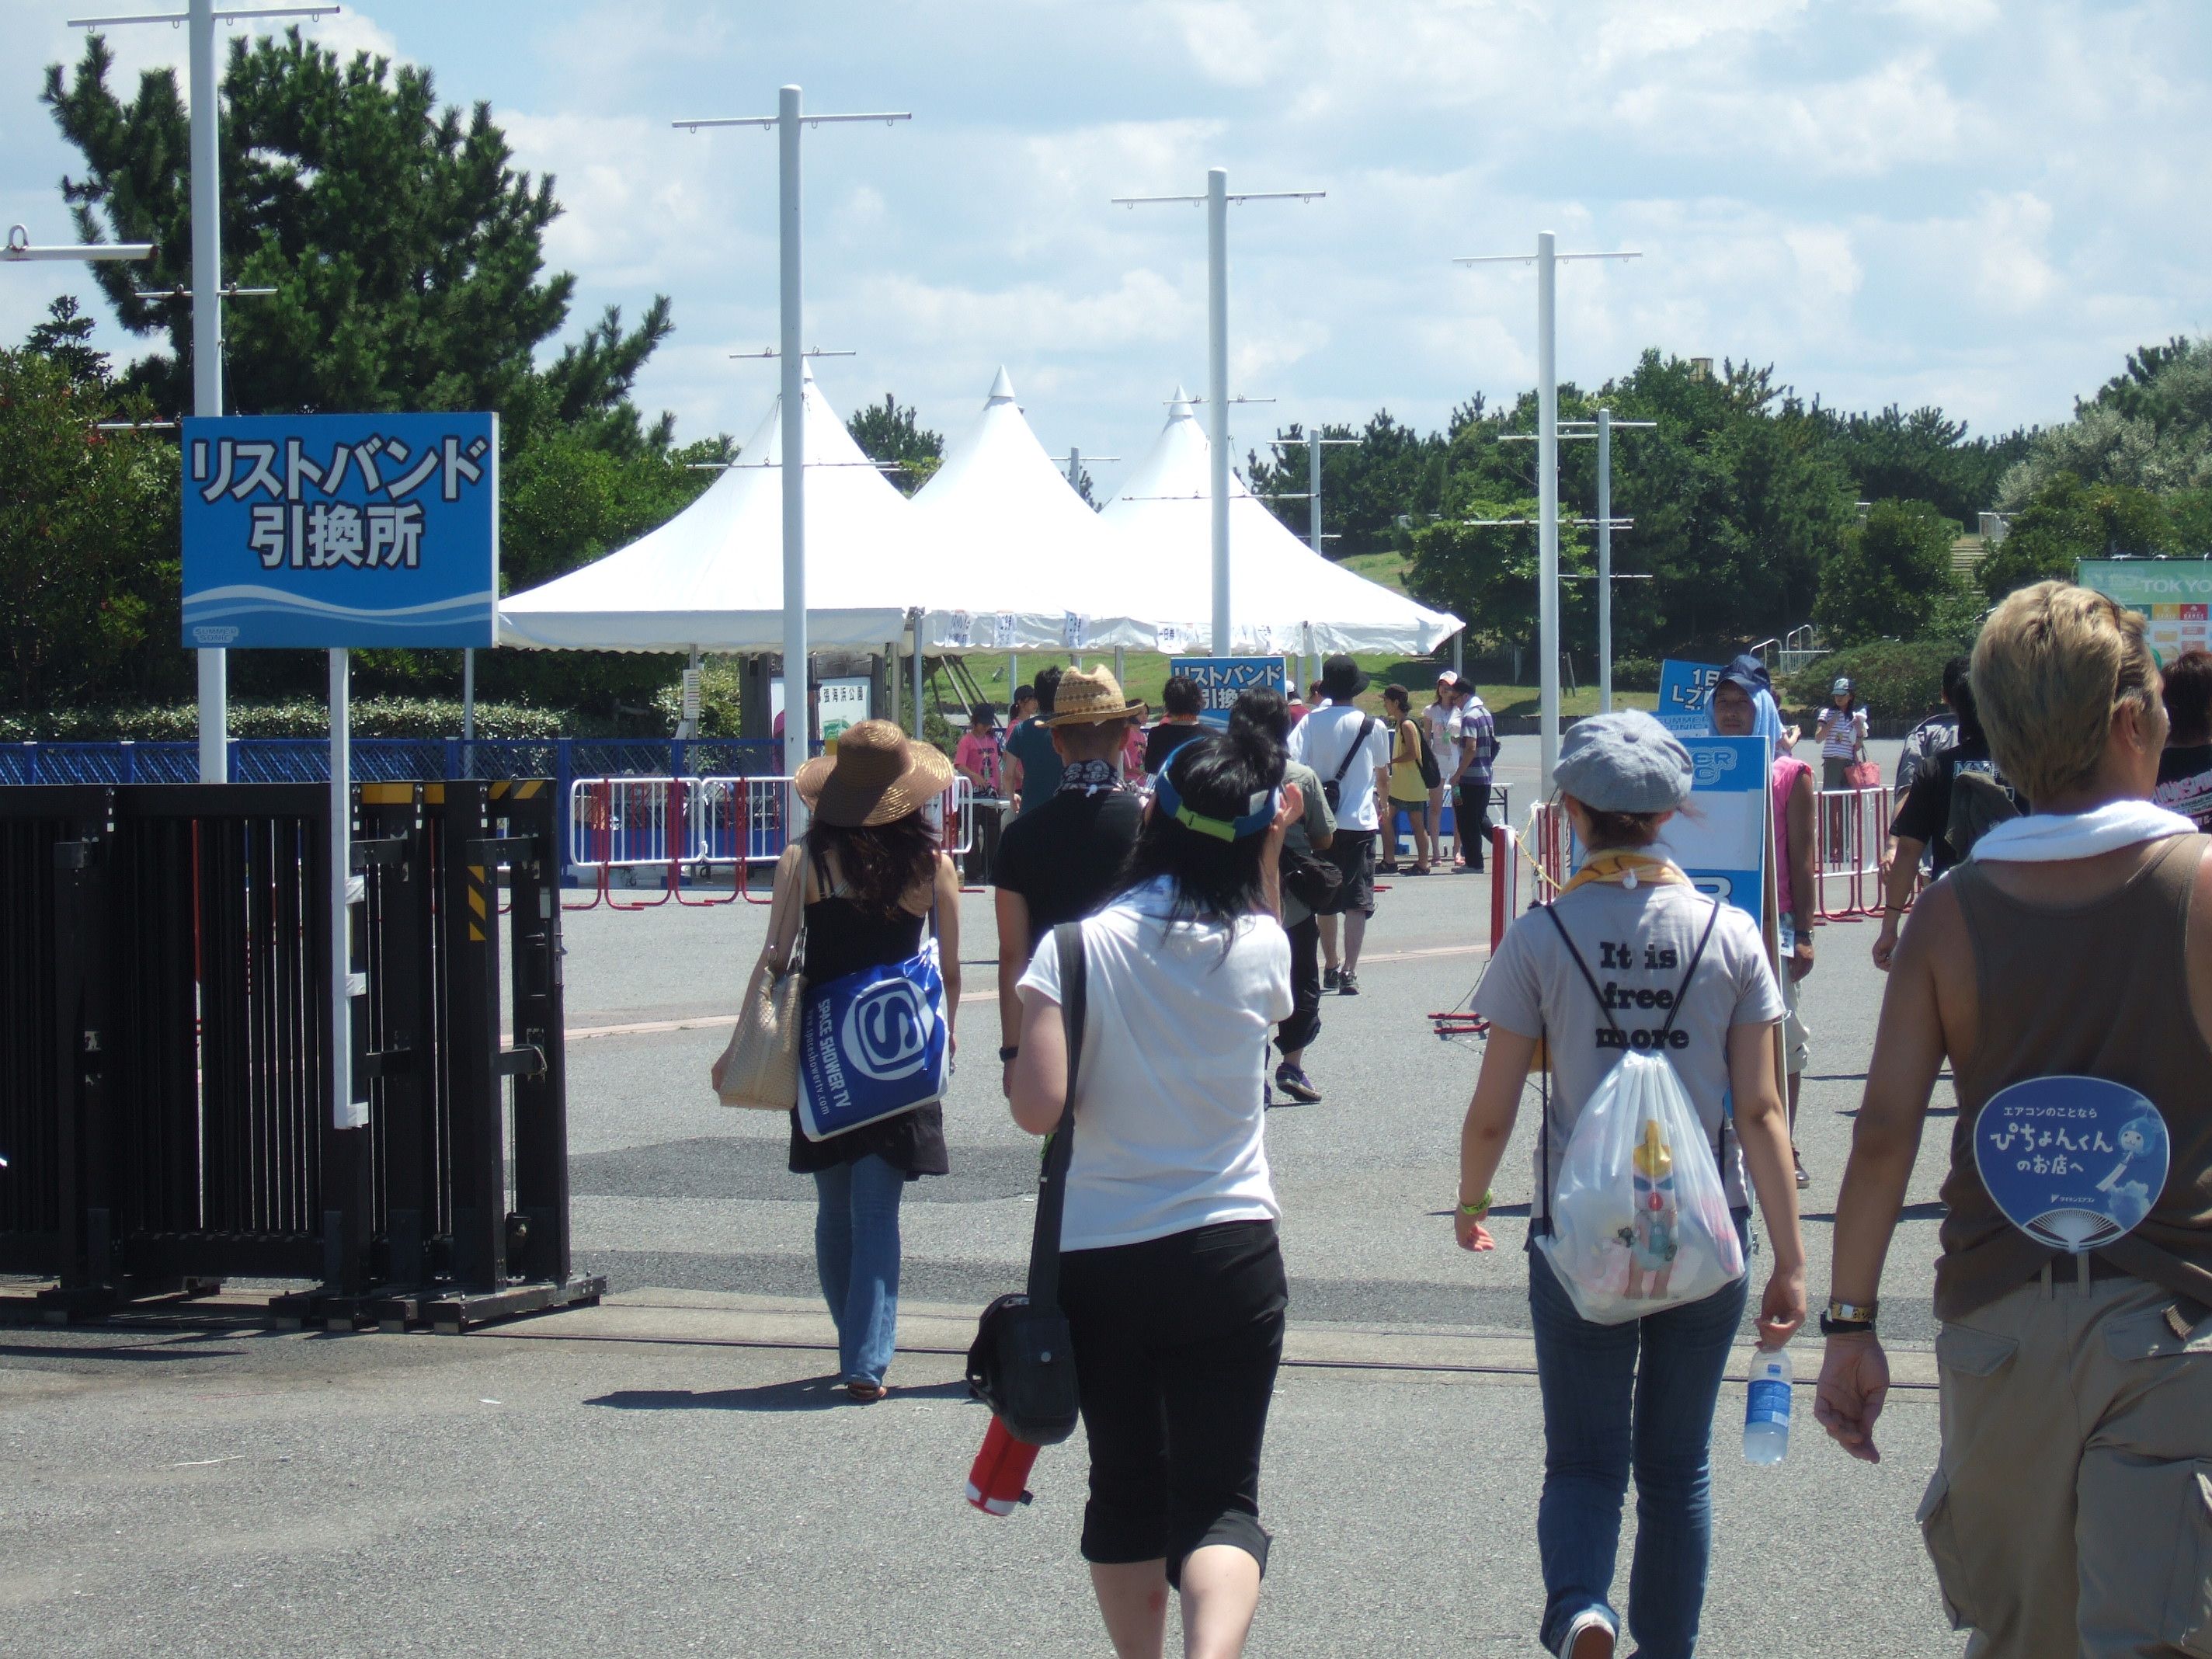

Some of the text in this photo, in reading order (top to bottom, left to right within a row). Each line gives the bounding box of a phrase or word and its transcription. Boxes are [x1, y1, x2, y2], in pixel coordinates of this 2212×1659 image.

[193, 436, 489, 502] リストバンド
[251, 503, 425, 569] 引換所
[2141, 579, 2212, 593] TOKYO
[1203, 688, 1250, 710] 引換
[1600, 941, 1678, 969] It is
[1604, 981, 1674, 1010] free
[1596, 1028, 1689, 1049] more
[817, 998, 852, 1108] SPACE SHOWER TV
[2003, 1107, 2098, 1118] エアコンのことなら
[1990, 1122, 2113, 1153] ぴちょんくん
[2016, 1154, 2085, 1175] のお店へ
